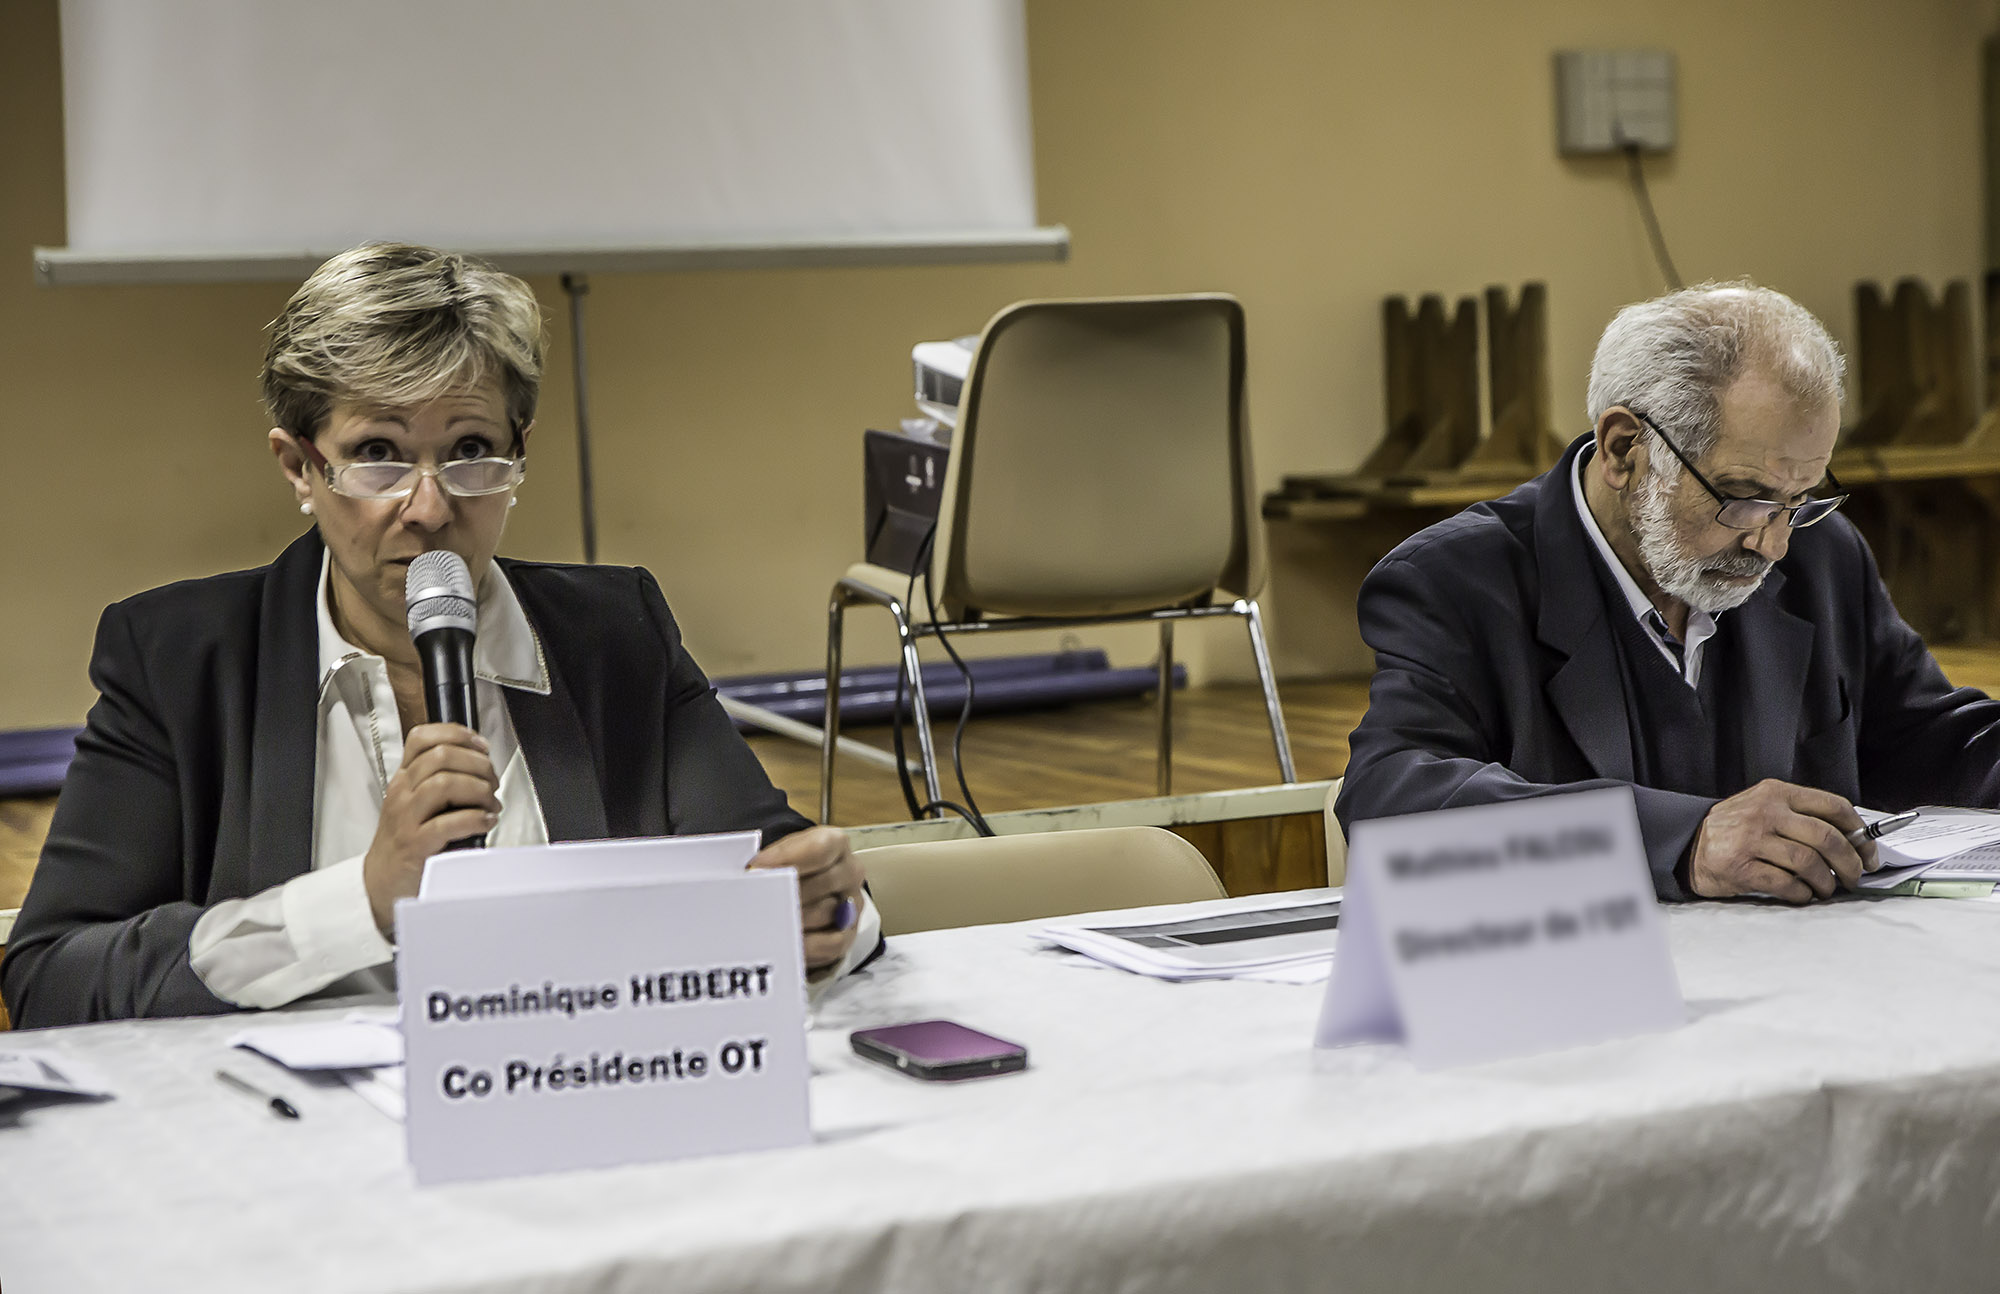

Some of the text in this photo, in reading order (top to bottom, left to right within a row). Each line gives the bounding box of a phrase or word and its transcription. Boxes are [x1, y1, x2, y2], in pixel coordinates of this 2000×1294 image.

[427, 965, 774, 1023] Dominique HEBERT
[442, 1038, 769, 1099] Co Présidente OT
